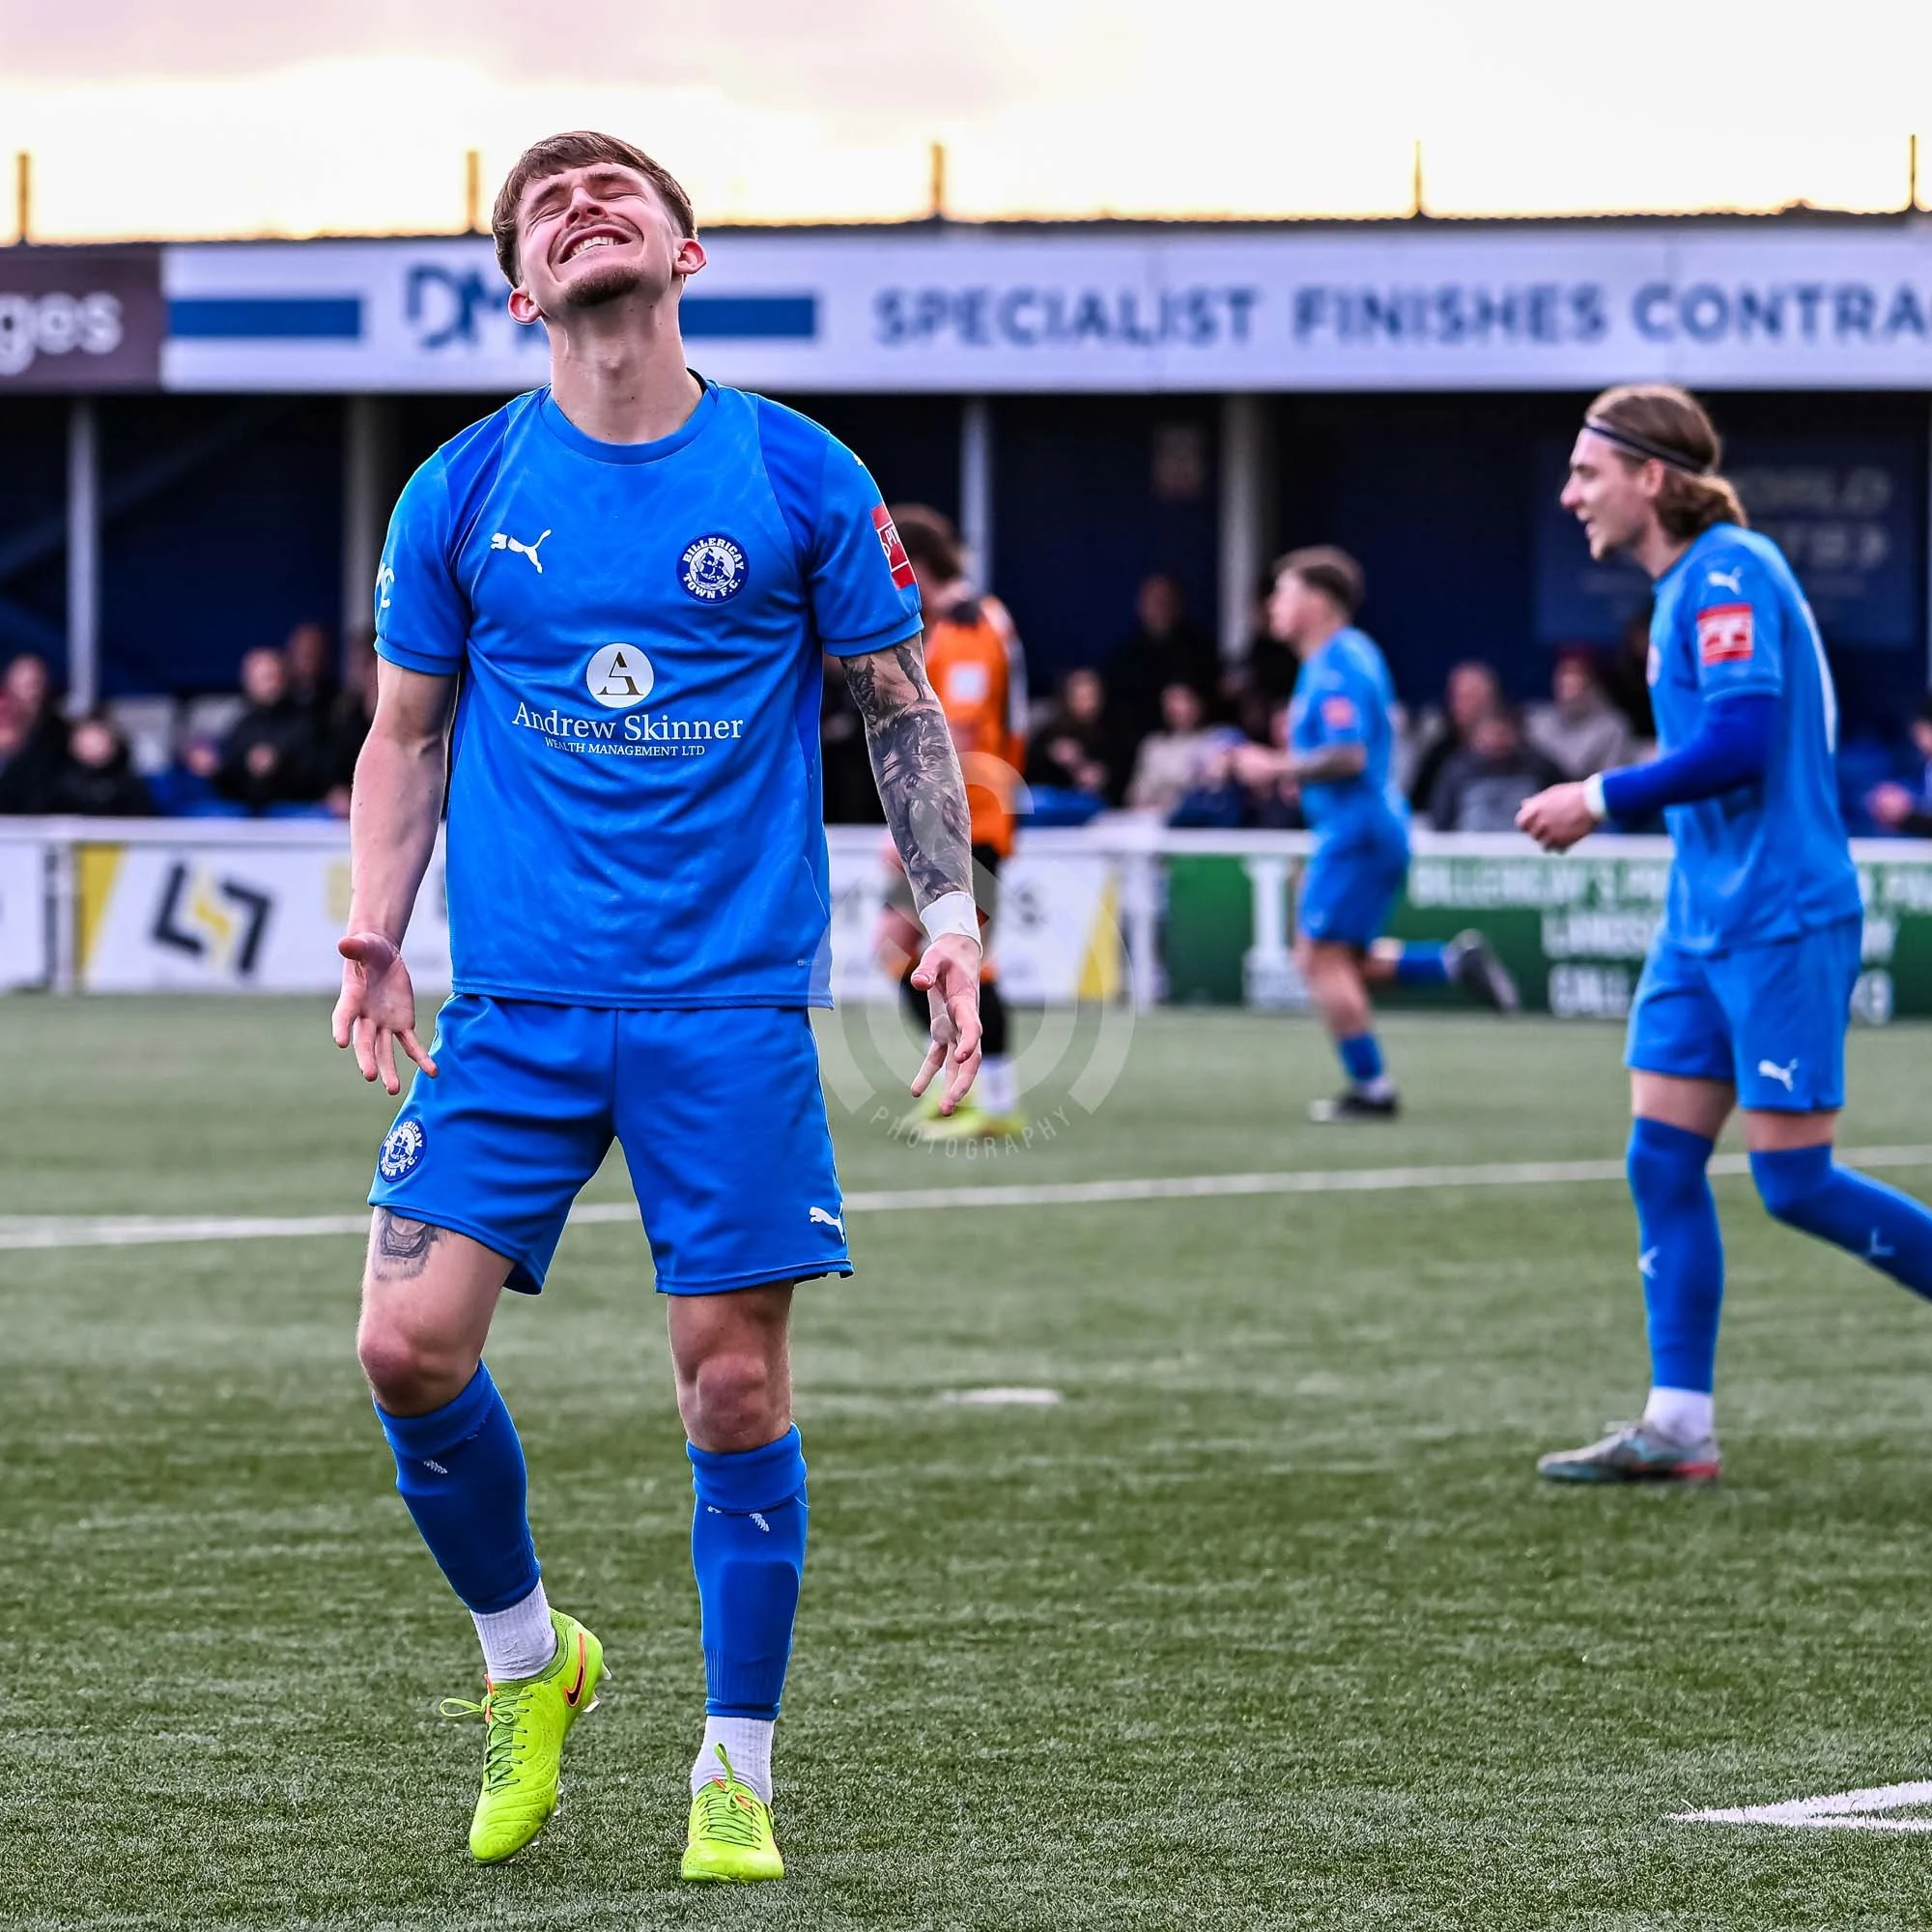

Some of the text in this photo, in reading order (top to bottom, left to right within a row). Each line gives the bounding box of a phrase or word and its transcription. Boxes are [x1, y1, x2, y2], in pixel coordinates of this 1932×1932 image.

[873, 285, 1258, 347] SPECIALIST
[1293, 285, 1608, 344] FINISHES
[682, 537, 745, 570] BILLERICAY
[682, 573, 741, 599] TOWN F.C.
[511, 701, 744, 741] Andrew Skinner
[545, 736, 705, 756] WEALTH MANAGEMENT LTD
